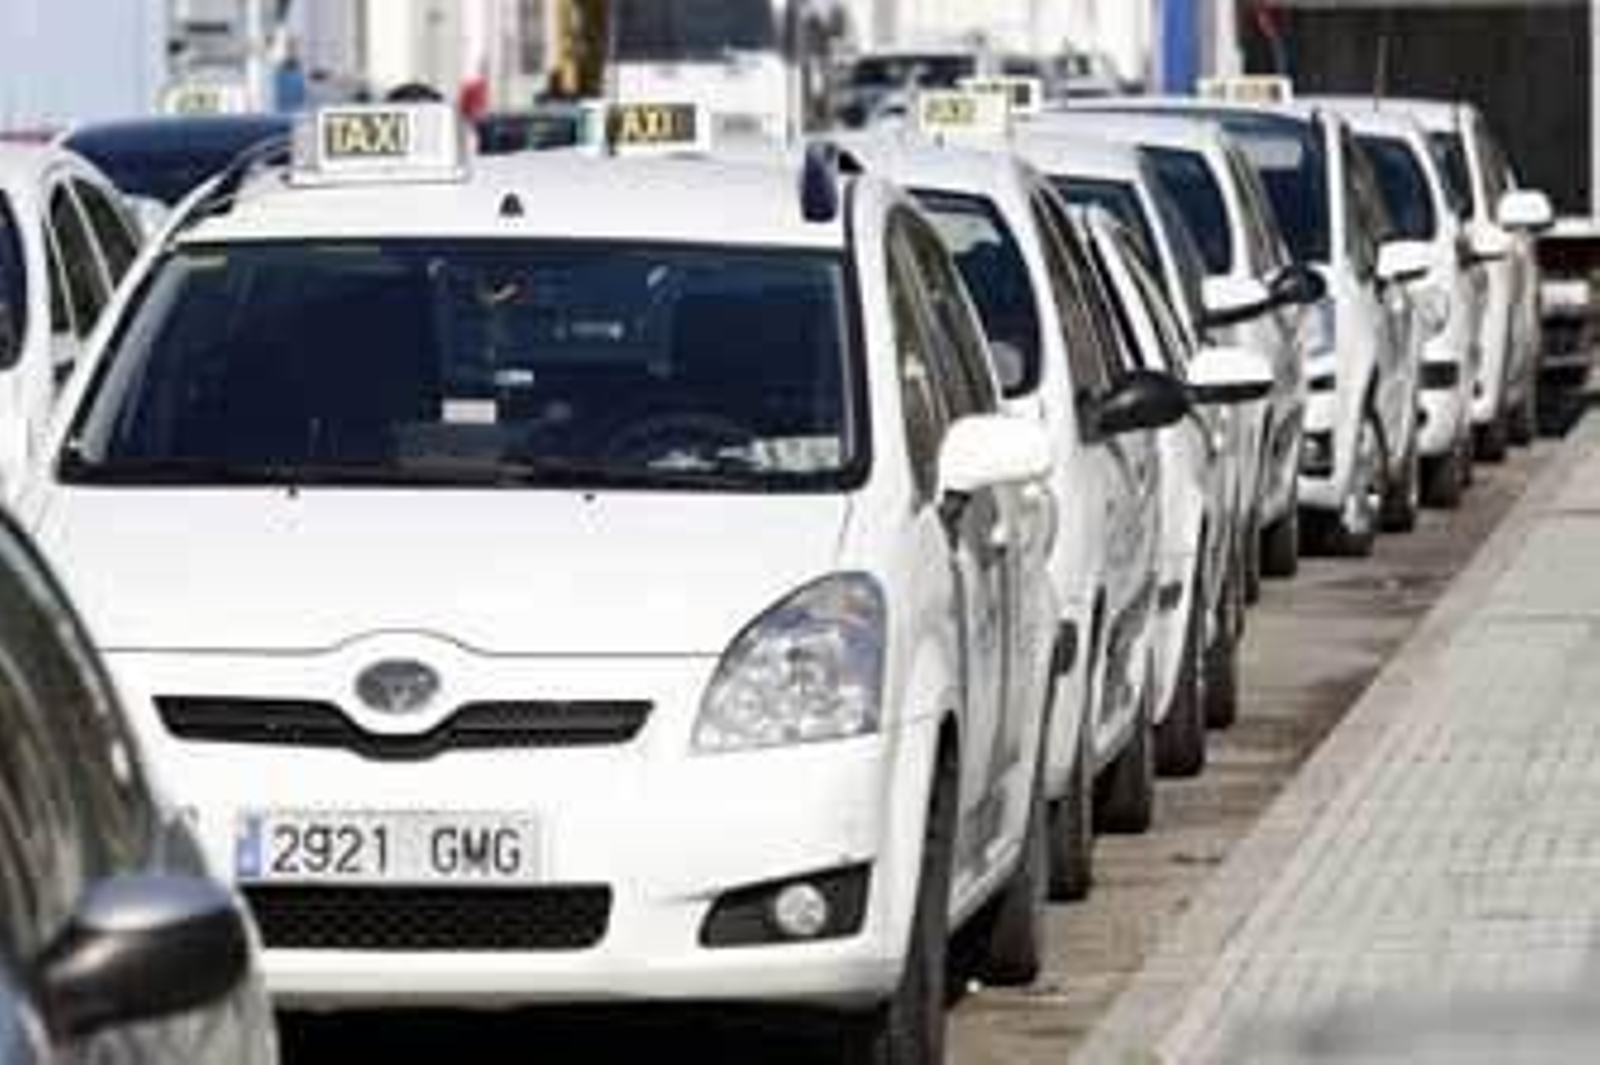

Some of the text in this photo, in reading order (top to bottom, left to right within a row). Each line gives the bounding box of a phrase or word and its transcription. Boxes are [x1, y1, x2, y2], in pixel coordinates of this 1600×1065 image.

[329, 115, 407, 152] TAXI
[272, 824, 521, 875] 2921 GMG
